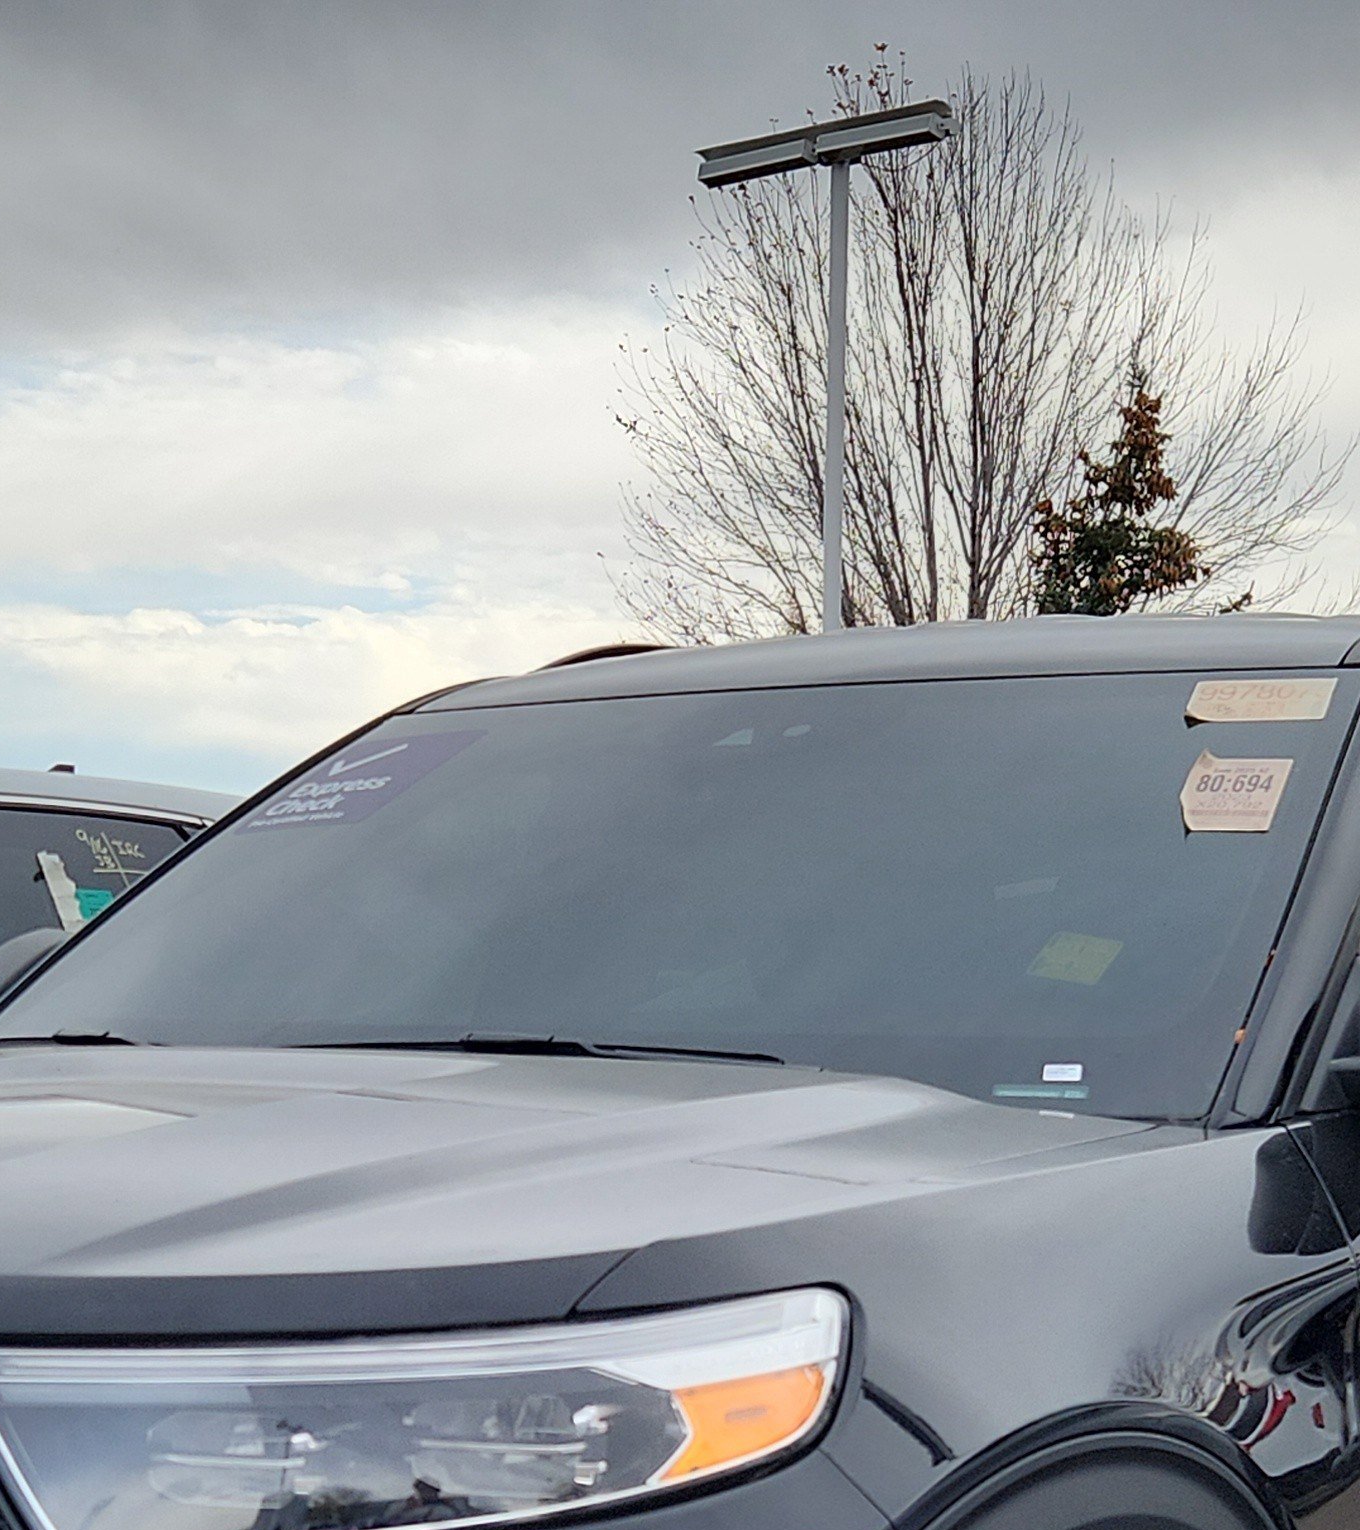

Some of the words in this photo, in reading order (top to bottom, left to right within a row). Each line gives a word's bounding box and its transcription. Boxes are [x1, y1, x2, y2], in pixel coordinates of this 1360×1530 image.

[289, 776, 391, 798] Express
[1196, 774, 1274, 793] 80:694
[265, 794, 345, 816] Check
